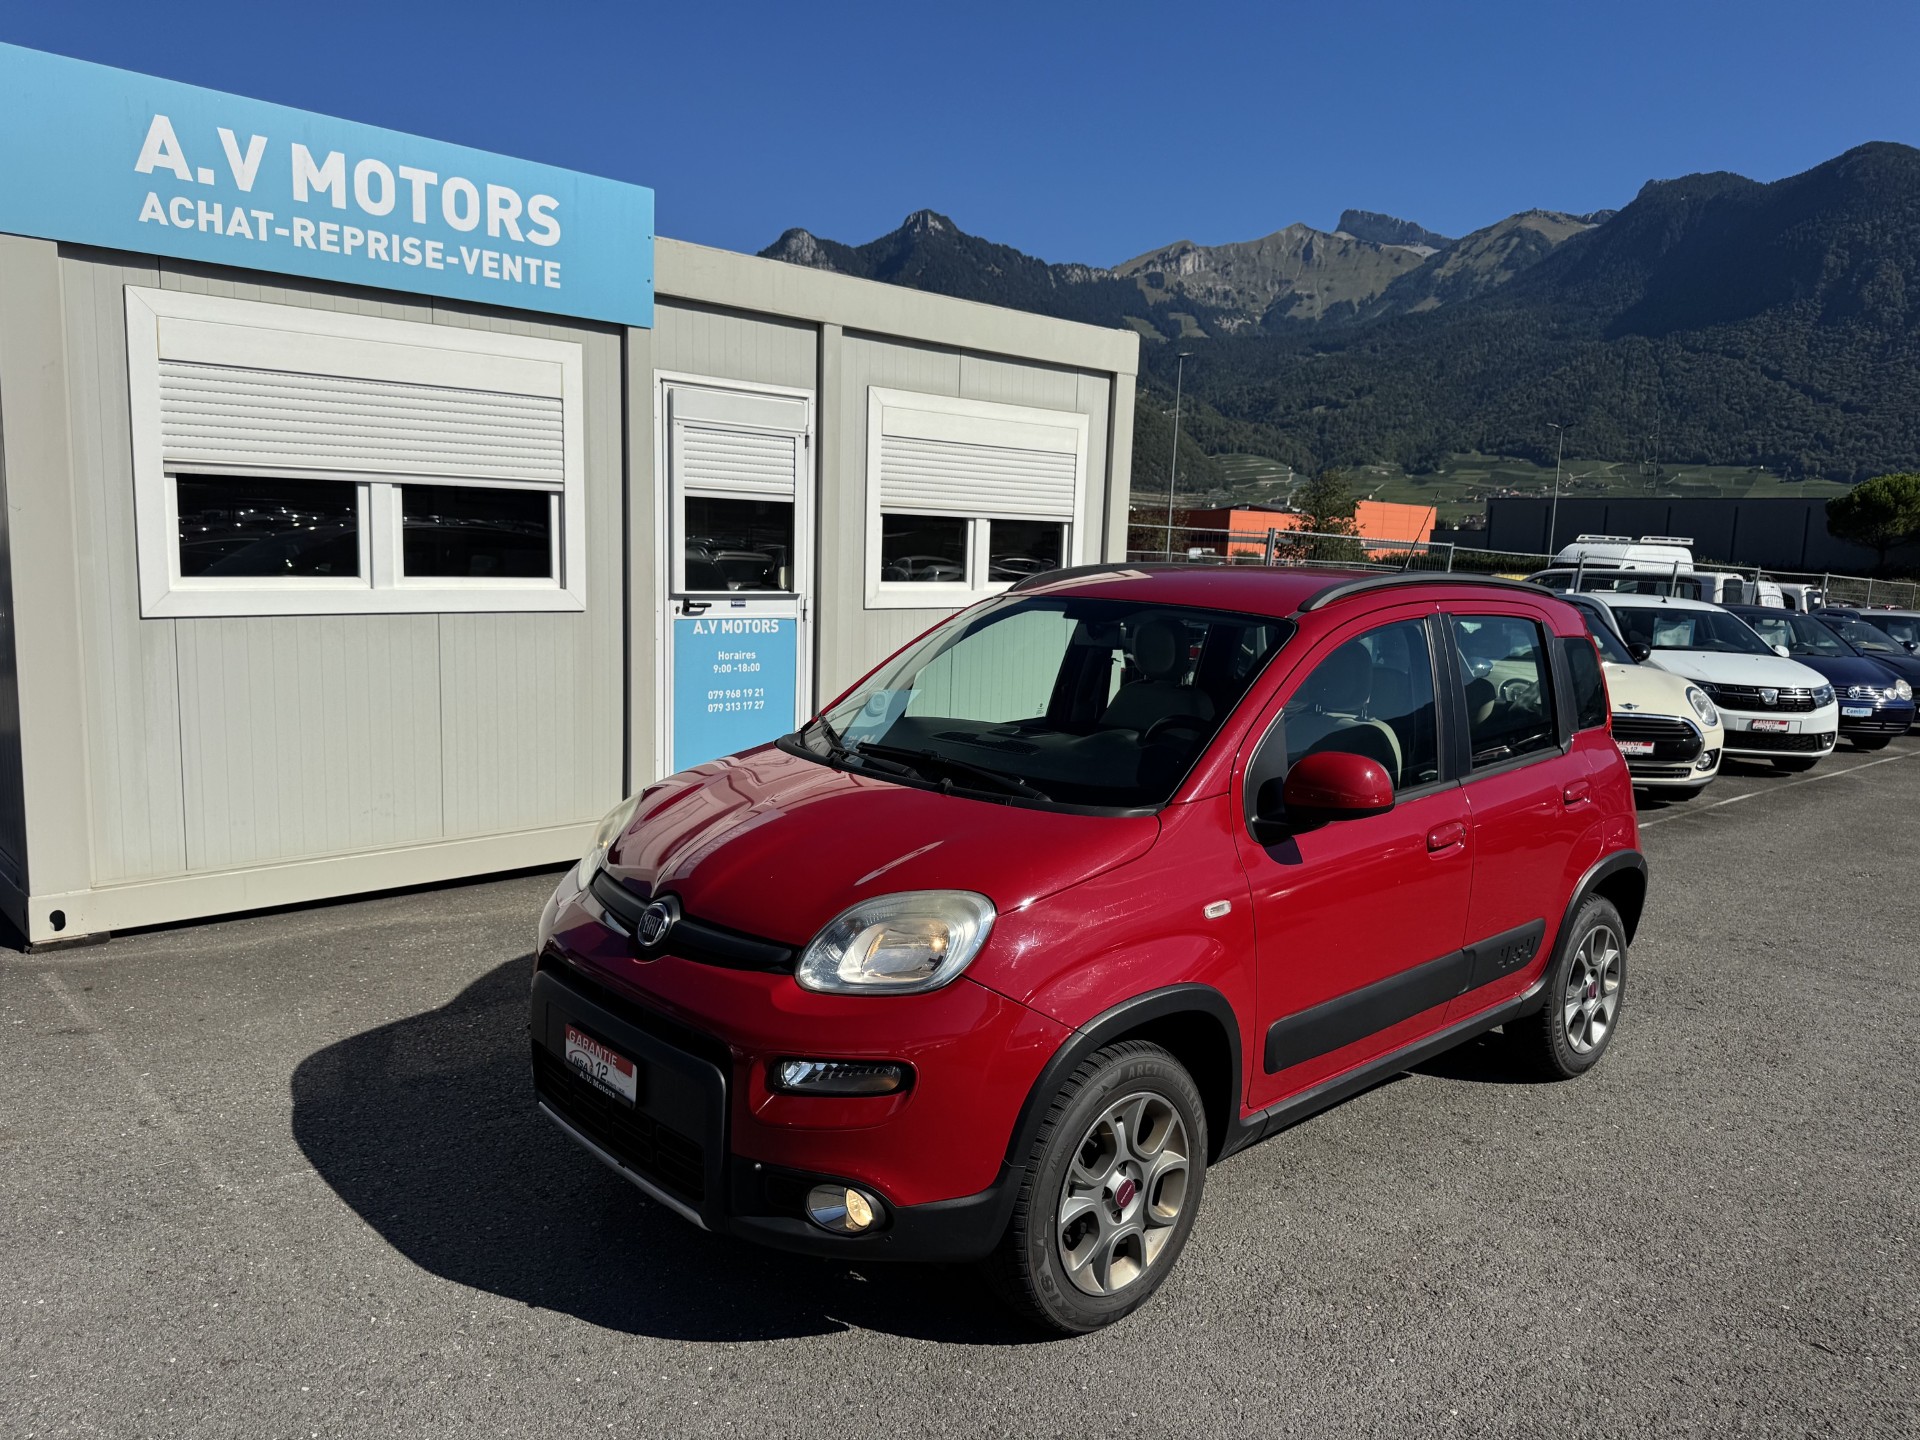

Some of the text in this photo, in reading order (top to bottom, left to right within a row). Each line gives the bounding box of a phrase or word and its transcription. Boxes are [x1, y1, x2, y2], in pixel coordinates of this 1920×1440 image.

[134, 113, 561, 247] A.V MOTORS
[138, 191, 561, 289] ACHAT-REPRISE-VENTE
[693, 619, 779, 634] A.V MOTORS
[718, 650, 756, 660] Horaires
[713, 664, 732, 673] 9:00
[708, 687, 764, 700] 079 968 19 21
[708, 700, 765, 713] 079 313 17 27
[642, 913, 662, 937] FIAT
[569, 1030, 618, 1068] GARANTIE
[573, 1055, 588, 1072] NSA
[595, 1061, 608, 1081] 12
[593, 1080, 616, 1098] Motors
